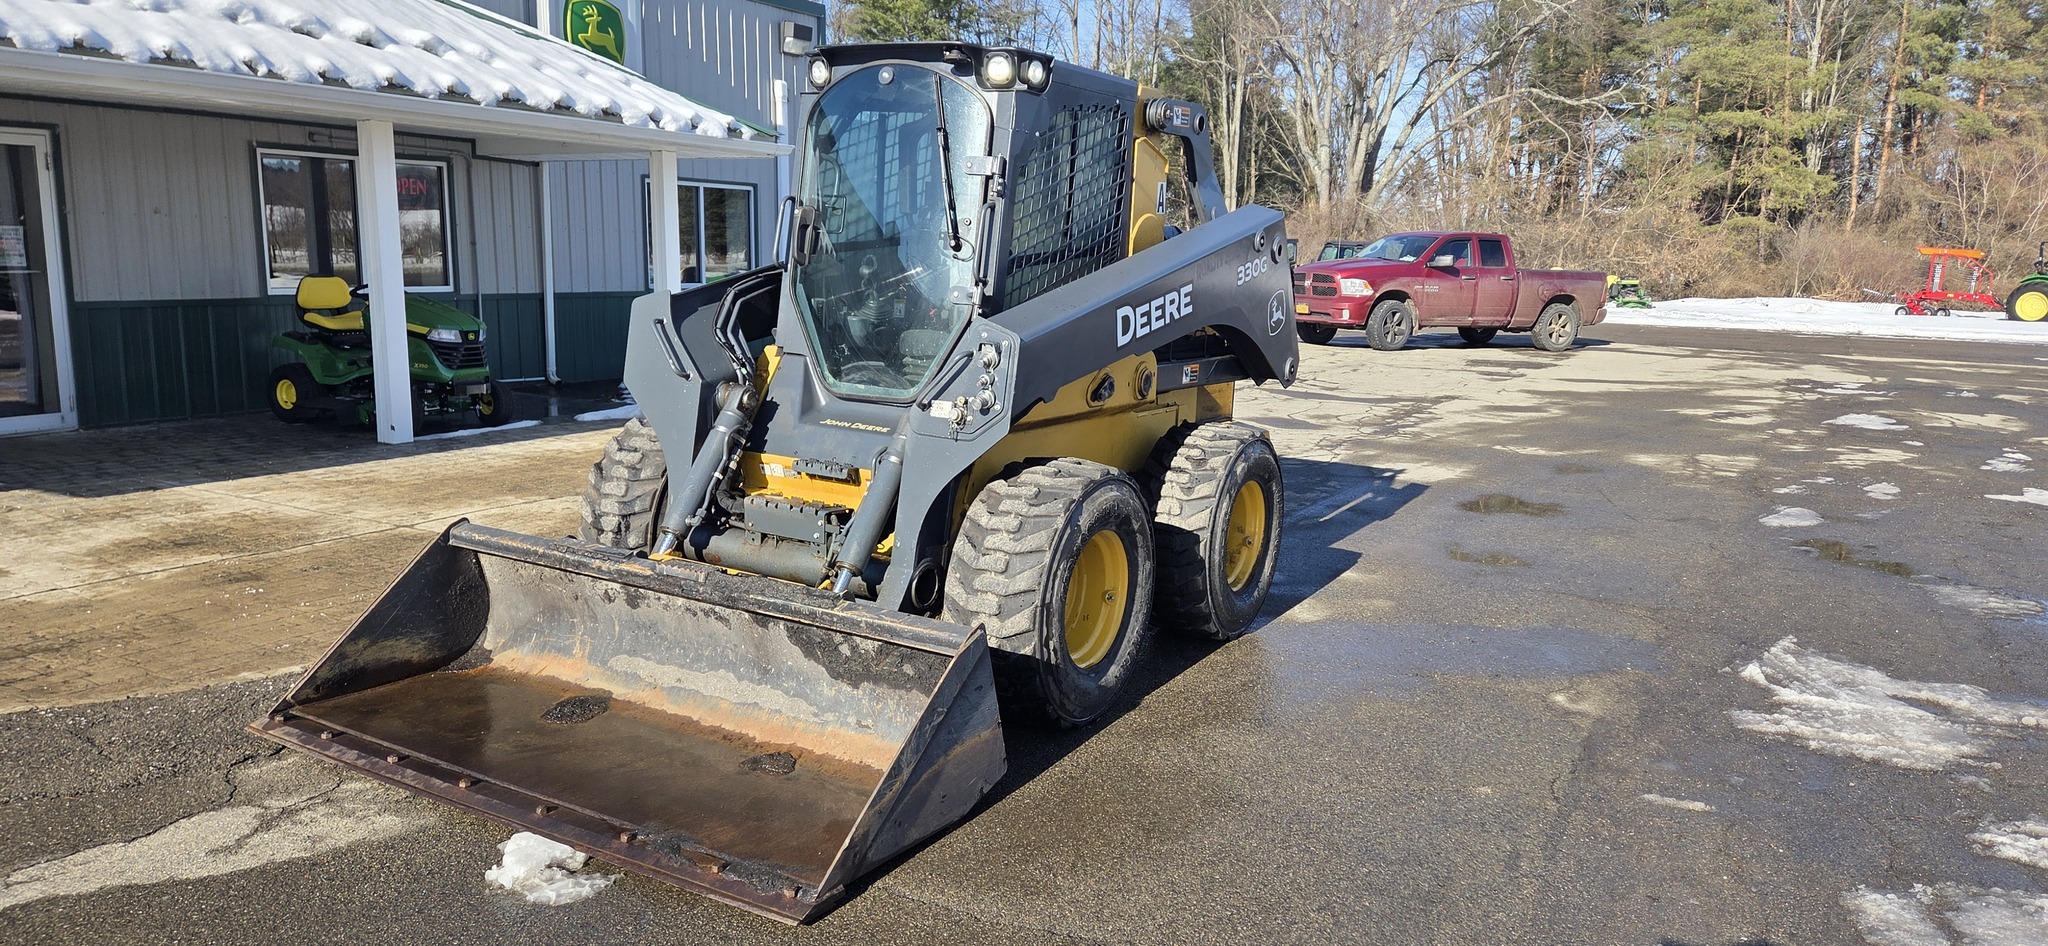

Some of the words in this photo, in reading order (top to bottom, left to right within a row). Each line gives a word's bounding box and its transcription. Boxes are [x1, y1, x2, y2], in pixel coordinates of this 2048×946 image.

[1156, 183, 1165, 213] A
[1237, 256, 1267, 286] 330G
[1116, 283, 1193, 348] DEERE
[820, 419, 851, 427] JOHN
[851, 423, 890, 432] DEERE
